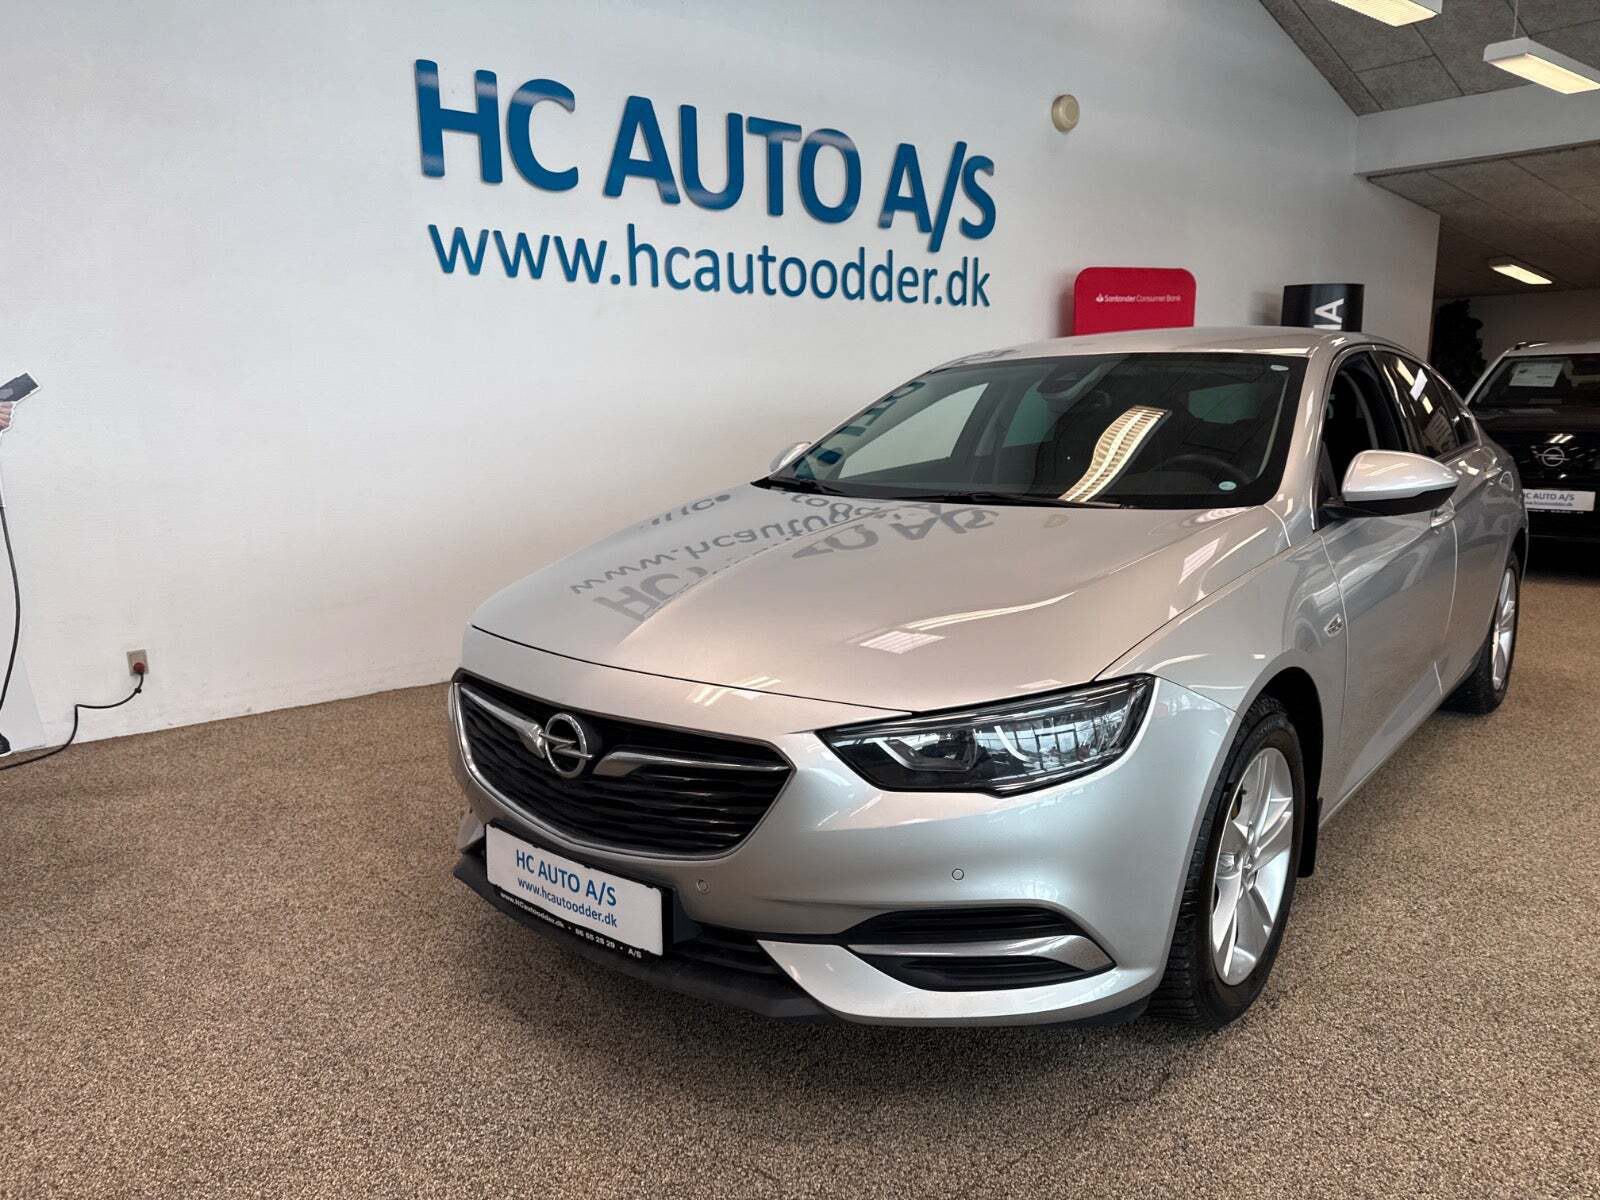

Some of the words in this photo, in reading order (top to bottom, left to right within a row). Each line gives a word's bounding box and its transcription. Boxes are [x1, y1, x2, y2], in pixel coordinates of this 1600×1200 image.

[414, 58, 579, 192] HC
[603, 95, 862, 224] AUTO
[878, 141, 997, 253] A/S
[428, 223, 991, 308] www.hcautoodder.dk
[1104, 294, 1136, 303] Santander
[1136, 294, 1166, 303] Consumer
[1166, 294, 1181, 303] Bank
[1533, 492, 1557, 501] AUTO
[1559, 493, 1575, 502] A/S
[516, 849, 535, 874] HC
[538, 860, 581, 894] AUTO
[585, 880, 617, 907] A/S
[517, 877, 618, 928] www.hcautoodder.dk
